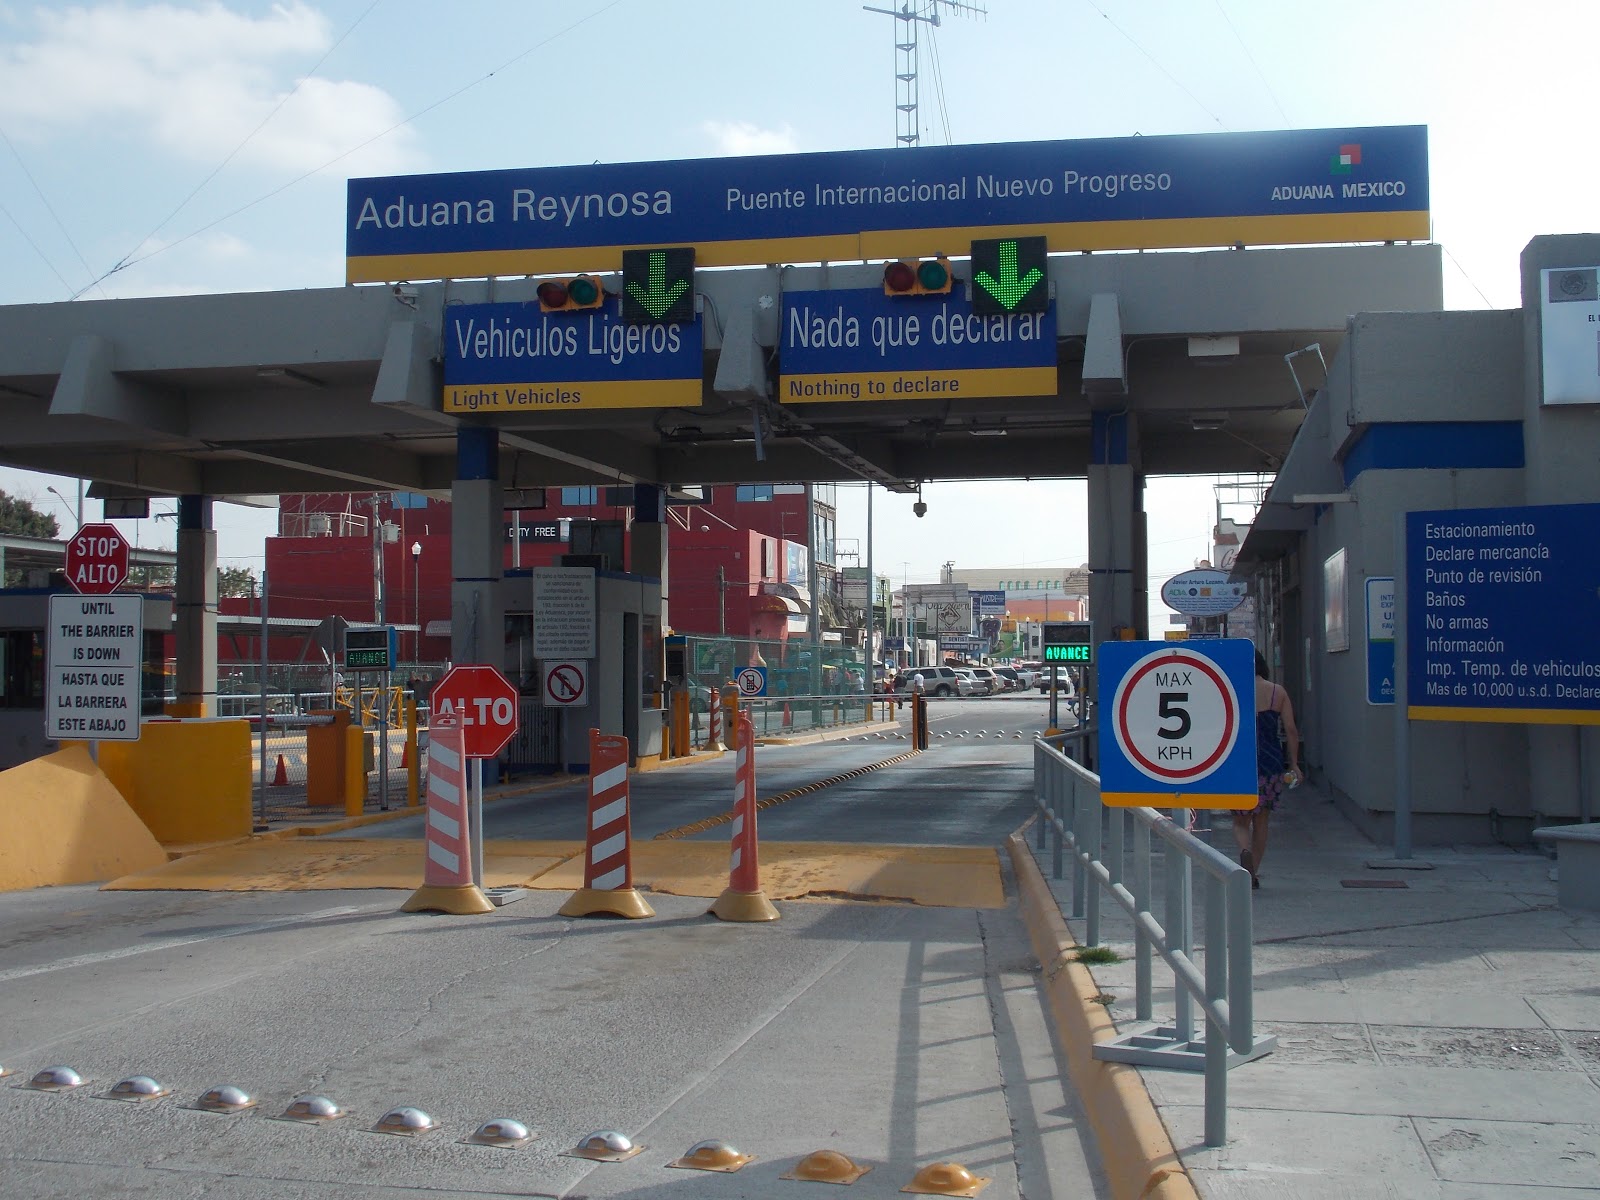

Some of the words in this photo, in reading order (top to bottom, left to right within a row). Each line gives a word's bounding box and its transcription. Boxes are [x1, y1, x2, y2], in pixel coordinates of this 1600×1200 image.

[727, 186, 806, 212] Puente
[815, 176, 967, 207] Internacional
[976, 173, 1054, 199] Nuevo
[1064, 169, 1172, 201] Progreso
[1271, 186, 1334, 201] ADUANA
[1342, 181, 1406, 198] MEXICO
[355, 197, 495, 231] Aduana
[513, 188, 673, 229] Reynosa
[789, 306, 861, 349] Nada
[871, 315, 921, 357] que
[931, 303, 1045, 344] declarar
[455, 317, 578, 360] Vehiculos
[588, 314, 681, 365] Ligeros
[789, 377, 861, 400] Nothing
[867, 377, 886, 395] to
[893, 374, 960, 394] declare
[452, 388, 501, 410] Light
[506, 387, 582, 406] Vehicles
[508, 527, 530, 538] DTY
[534, 526, 556, 537] FREE
[1425, 521, 1536, 539] Estacionamiento
[76, 536, 120, 558] STOP
[1425, 546, 1475, 562] Declare
[1479, 543, 1550, 560] mercancía
[76, 563, 118, 585] ALTO
[1425, 568, 1464, 584] Punto
[1468, 568, 1484, 583] de
[1489, 566, 1542, 583] revisión
[1426, 591, 1466, 607] Baños
[81, 602, 115, 615] UNTIL
[1426, 614, 1444, 630] No
[1449, 615, 1489, 630] armas
[61, 625, 83, 638] THE
[86, 625, 134, 638] BARRIER
[73, 647, 84, 660] IS
[87, 647, 120, 660] DOWN
[1045, 645, 1089, 661] AVANCE
[1426, 636, 1504, 653] Información
[349, 651, 387, 665] AVANCE
[1426, 659, 1456, 679] Imp.
[1461, 660, 1505, 680] Temp.
[1510, 660, 1528, 677] de
[1533, 660, 1600, 678] vehiculos
[62, 673, 100, 686] HASTA
[101, 673, 125, 687] QUE
[1156, 671, 1192, 688] MAX
[1427, 682, 1451, 696] Mas
[1453, 682, 1468, 696] de
[1472, 682, 1514, 700] 10,000
[1518, 683, 1552, 698] u.s.d.
[1556, 683, 1600, 699] Declare
[58, 695, 73, 708] LA
[75, 696, 127, 709] BARRERA
[437, 697, 514, 726] ALTO
[1156, 692, 1192, 740] 5
[58, 718, 86, 731] ESTE
[88, 718, 126, 732] ABAJO
[1157, 746, 1192, 761] KPH
